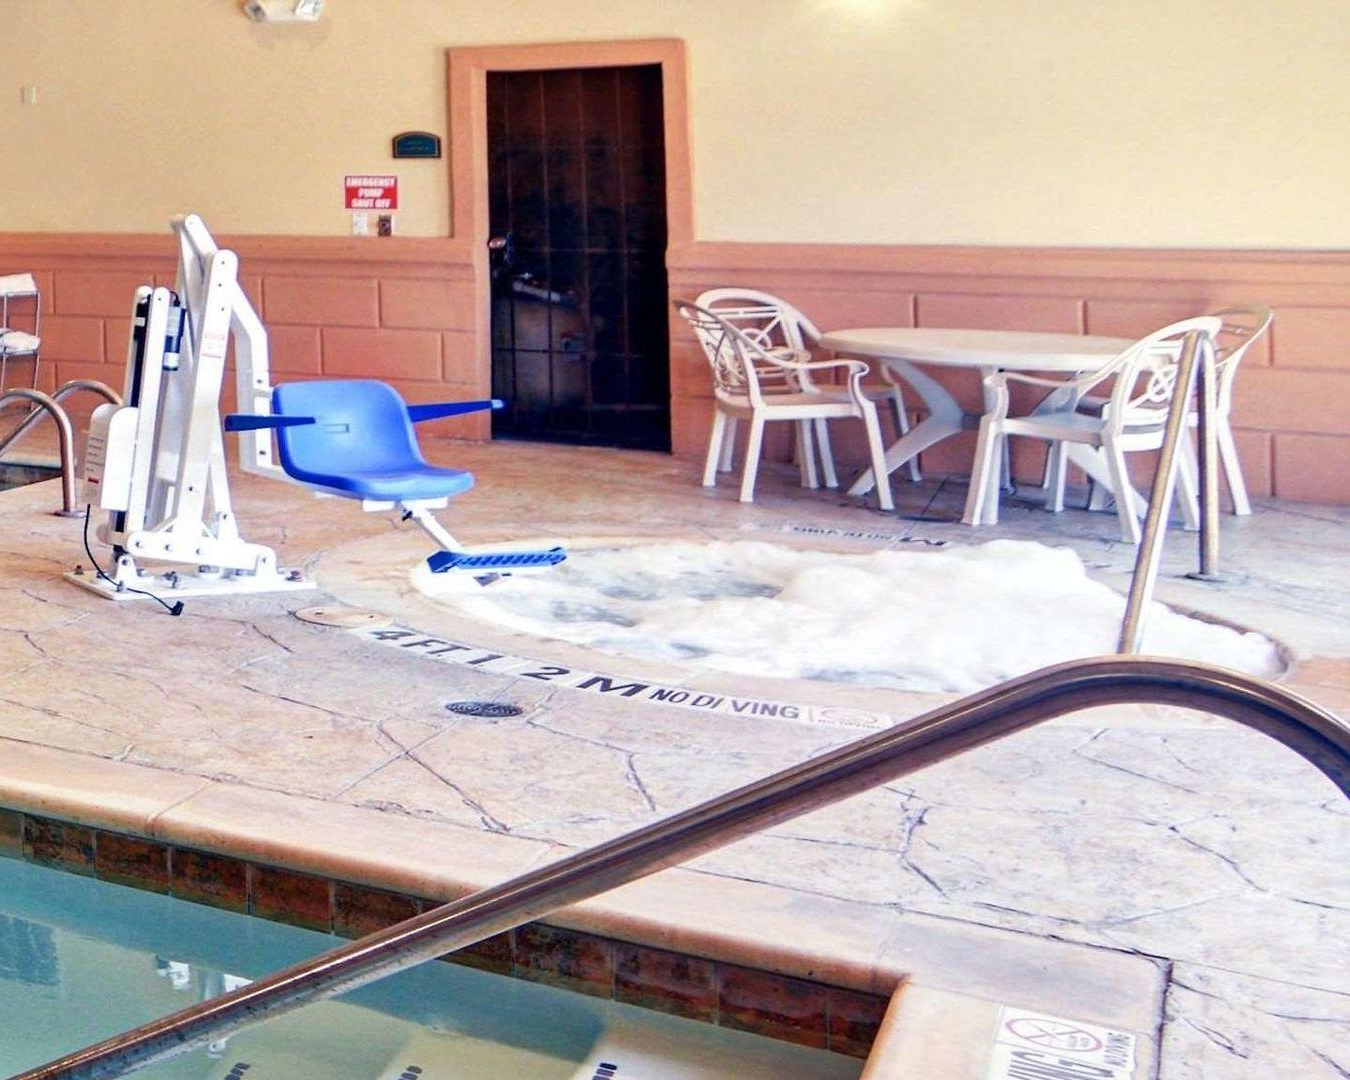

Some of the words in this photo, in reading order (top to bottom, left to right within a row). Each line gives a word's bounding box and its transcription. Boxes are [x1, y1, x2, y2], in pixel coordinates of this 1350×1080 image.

[346, 177, 396, 187] EMERGENCY
[374, 198, 391, 208] OFF
[369, 630, 415, 640] 4
[648, 688, 690, 704] NO
